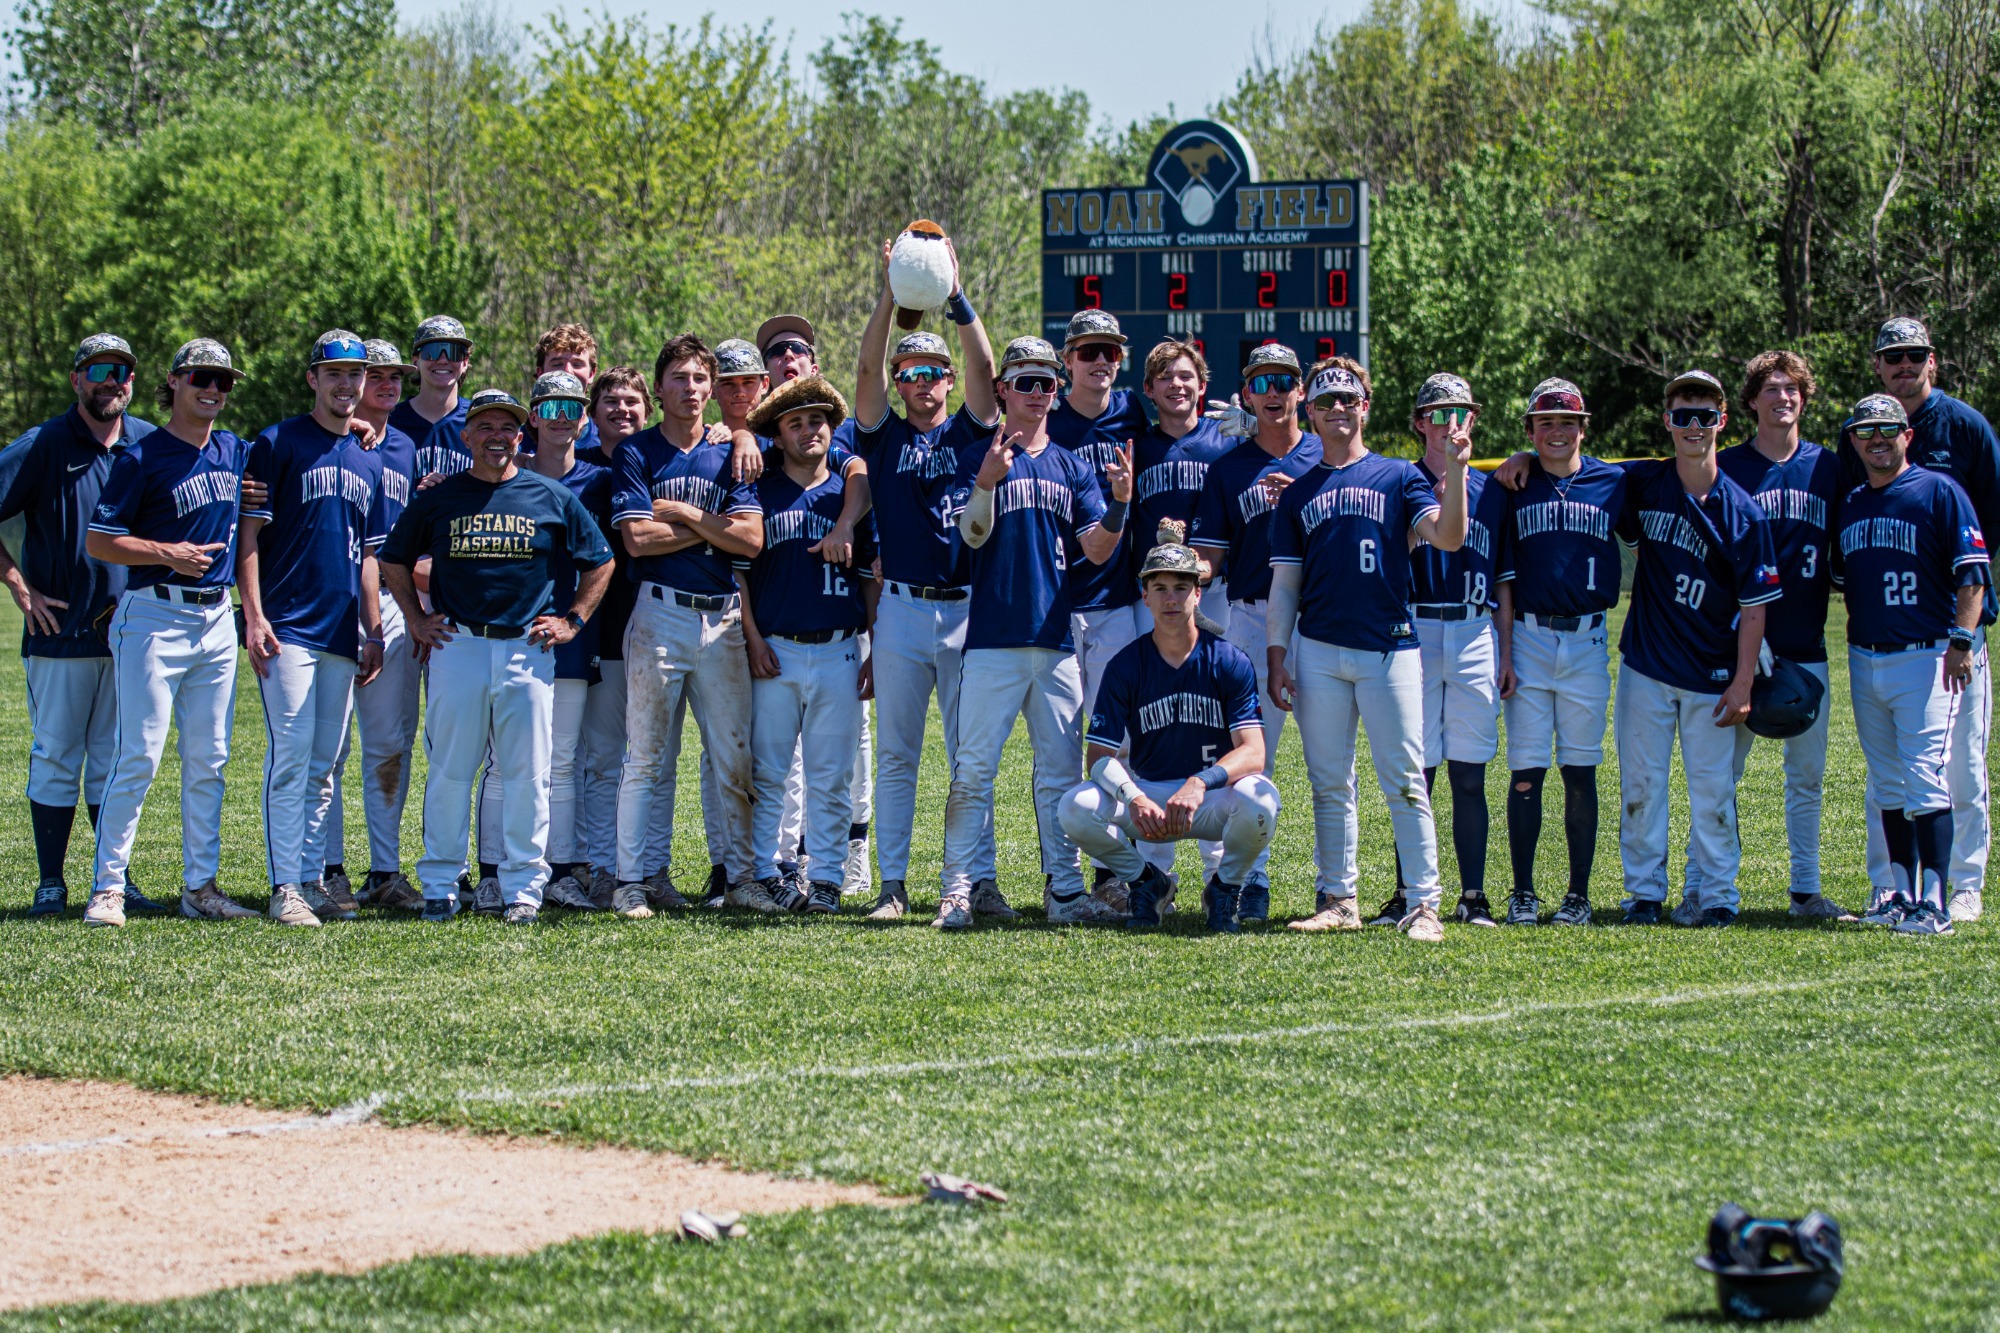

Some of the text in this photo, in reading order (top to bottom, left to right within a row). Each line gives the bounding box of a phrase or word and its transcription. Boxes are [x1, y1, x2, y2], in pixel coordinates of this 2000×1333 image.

[1046, 184, 1354, 236] NOAH FIELD
[1089, 237, 1104, 248] AT
[1324, 248, 1352, 270] OUT
[1063, 253, 1115, 276] INNING
[1162, 251, 1195, 274] BALL
[1242, 249, 1293, 272] STRIKE
[1083, 275, 1101, 310] 5
[1169, 273, 1187, 309] 2
[1258, 271, 1277, 308] 2
[1328, 269, 1347, 307] 0
[1167, 312, 1203, 334] RUNS
[1244, 311, 1276, 333] HITS
[1299, 309, 1352, 332] ERRORS
[1339, 487, 1386, 524] CHRISTIAN
[1516, 500, 1610, 542] MCKINNEY CHRISTIAN
[1784, 488, 1826, 531] CHRISTIAN
[449, 513, 536, 537] MUSTANGS
[1871, 517, 1918, 556] CHRISTIAN
[451, 536, 534, 553] BASEBALL
[1359, 538, 1376, 574] 6
[1802, 544, 1817, 578] 3
[822, 562, 849, 597] 12
[1462, 570, 1487, 605] 18
[1586, 556, 1596, 591] 1
[1883, 571, 1918, 606] 22
[1674, 573, 1707, 610] 20
[1178, 691, 1225, 730] CHRISTIAN
[1201, 744, 1217, 773] 5
